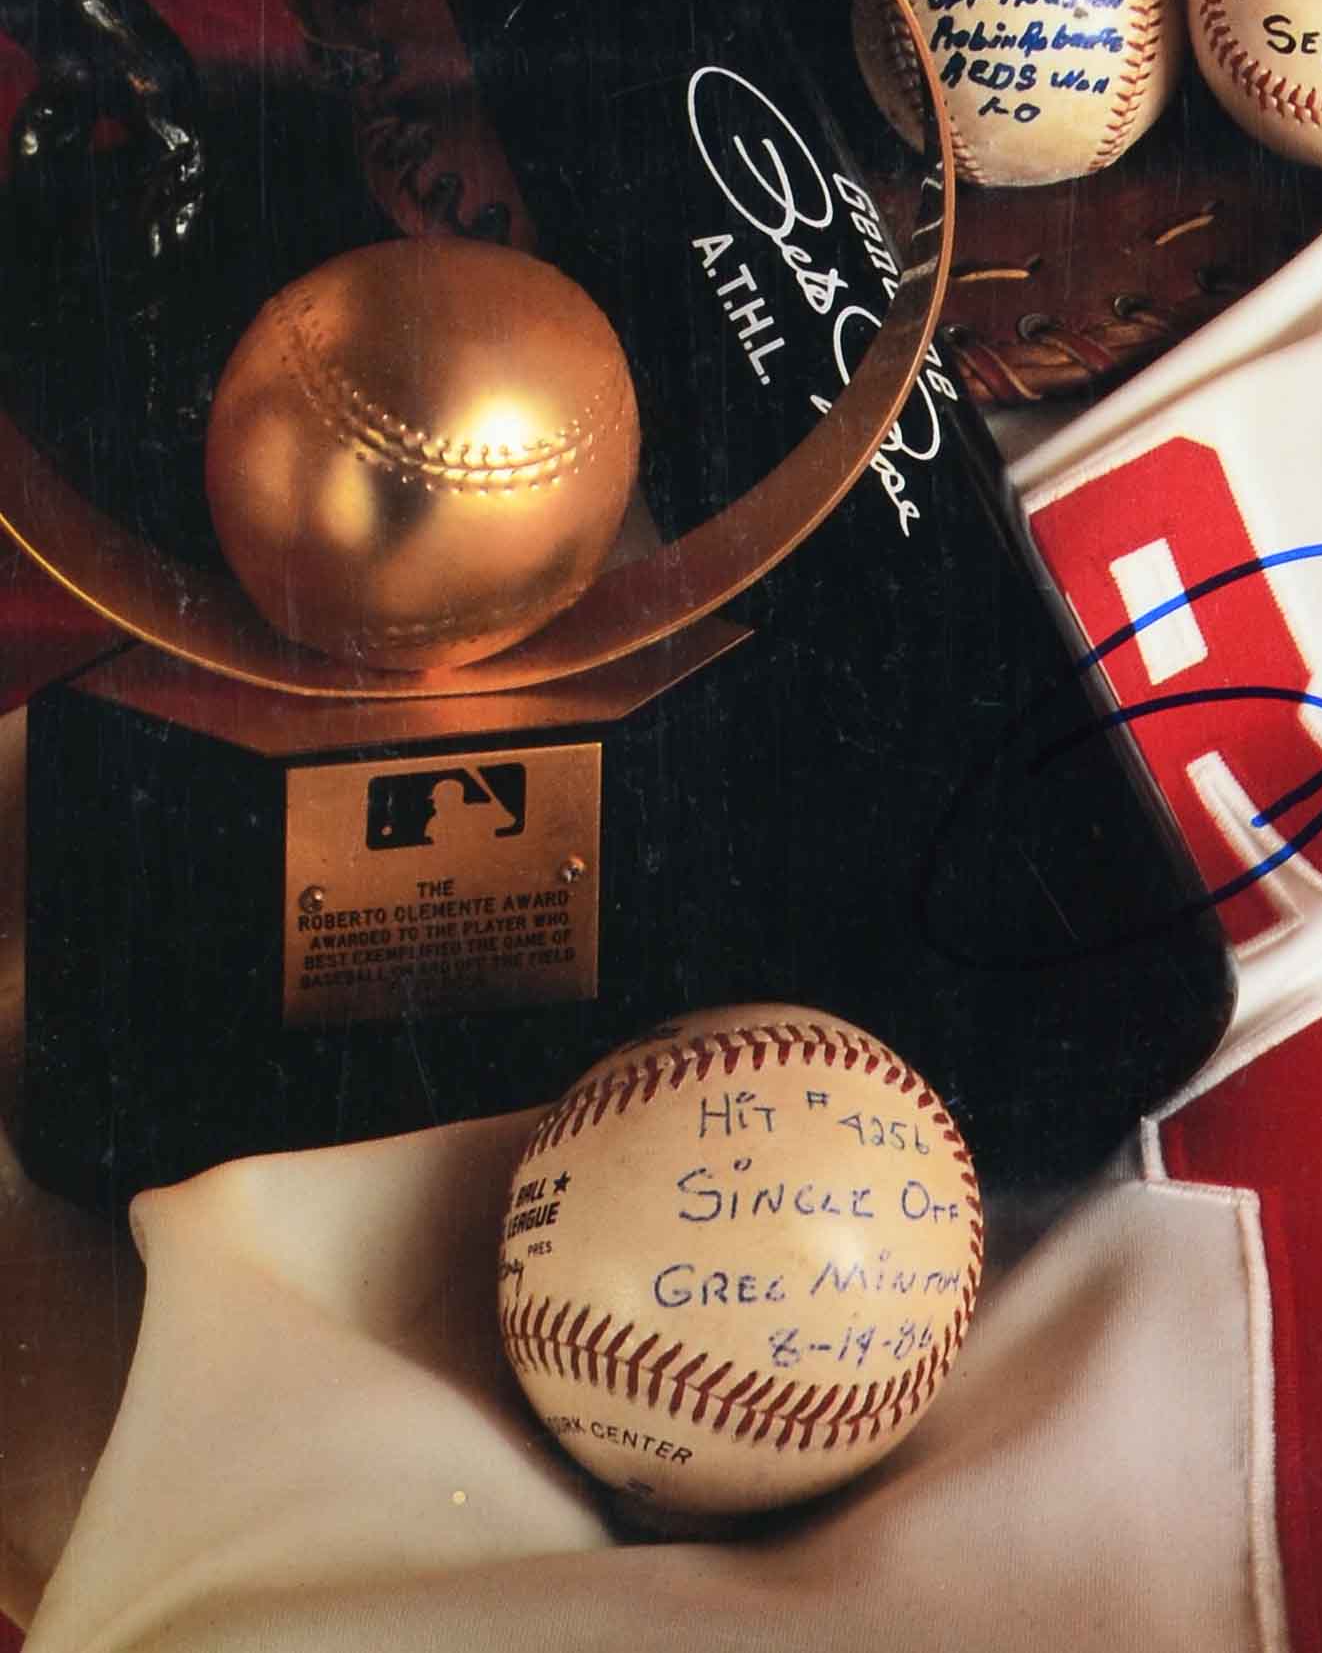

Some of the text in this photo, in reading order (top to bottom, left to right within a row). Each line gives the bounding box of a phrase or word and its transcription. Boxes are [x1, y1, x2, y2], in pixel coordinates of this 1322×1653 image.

[416, 879, 455, 897] THE
[298, 890, 569, 932] ROBERTO CLEMENTE AWARD
[506, 1201, 561, 1240] LEAGUE
[591, 1421, 694, 1465] CENTER
